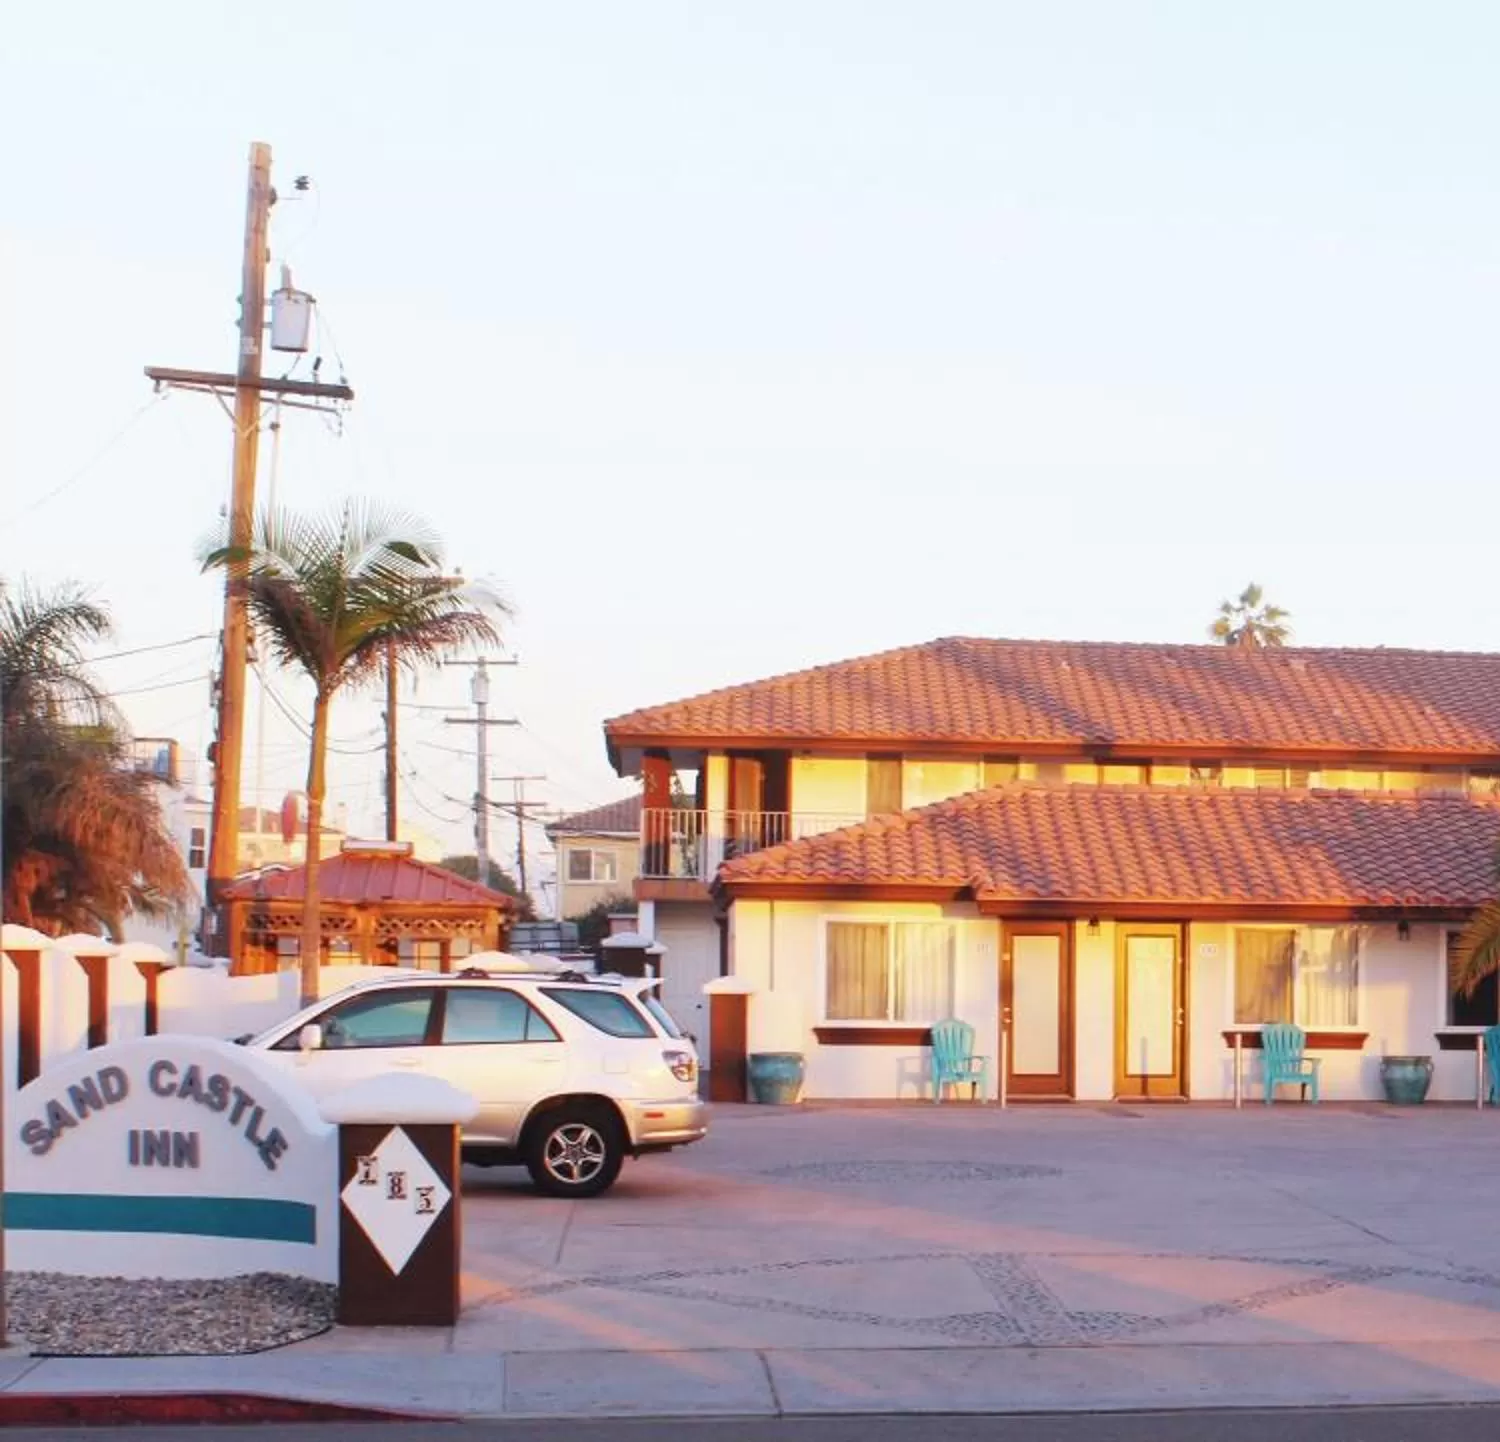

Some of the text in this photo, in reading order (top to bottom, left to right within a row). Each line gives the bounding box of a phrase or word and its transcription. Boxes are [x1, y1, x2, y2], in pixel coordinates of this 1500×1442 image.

[19, 1059, 289, 1171] SAND CASTLE
[127, 1128, 200, 1168] INN
